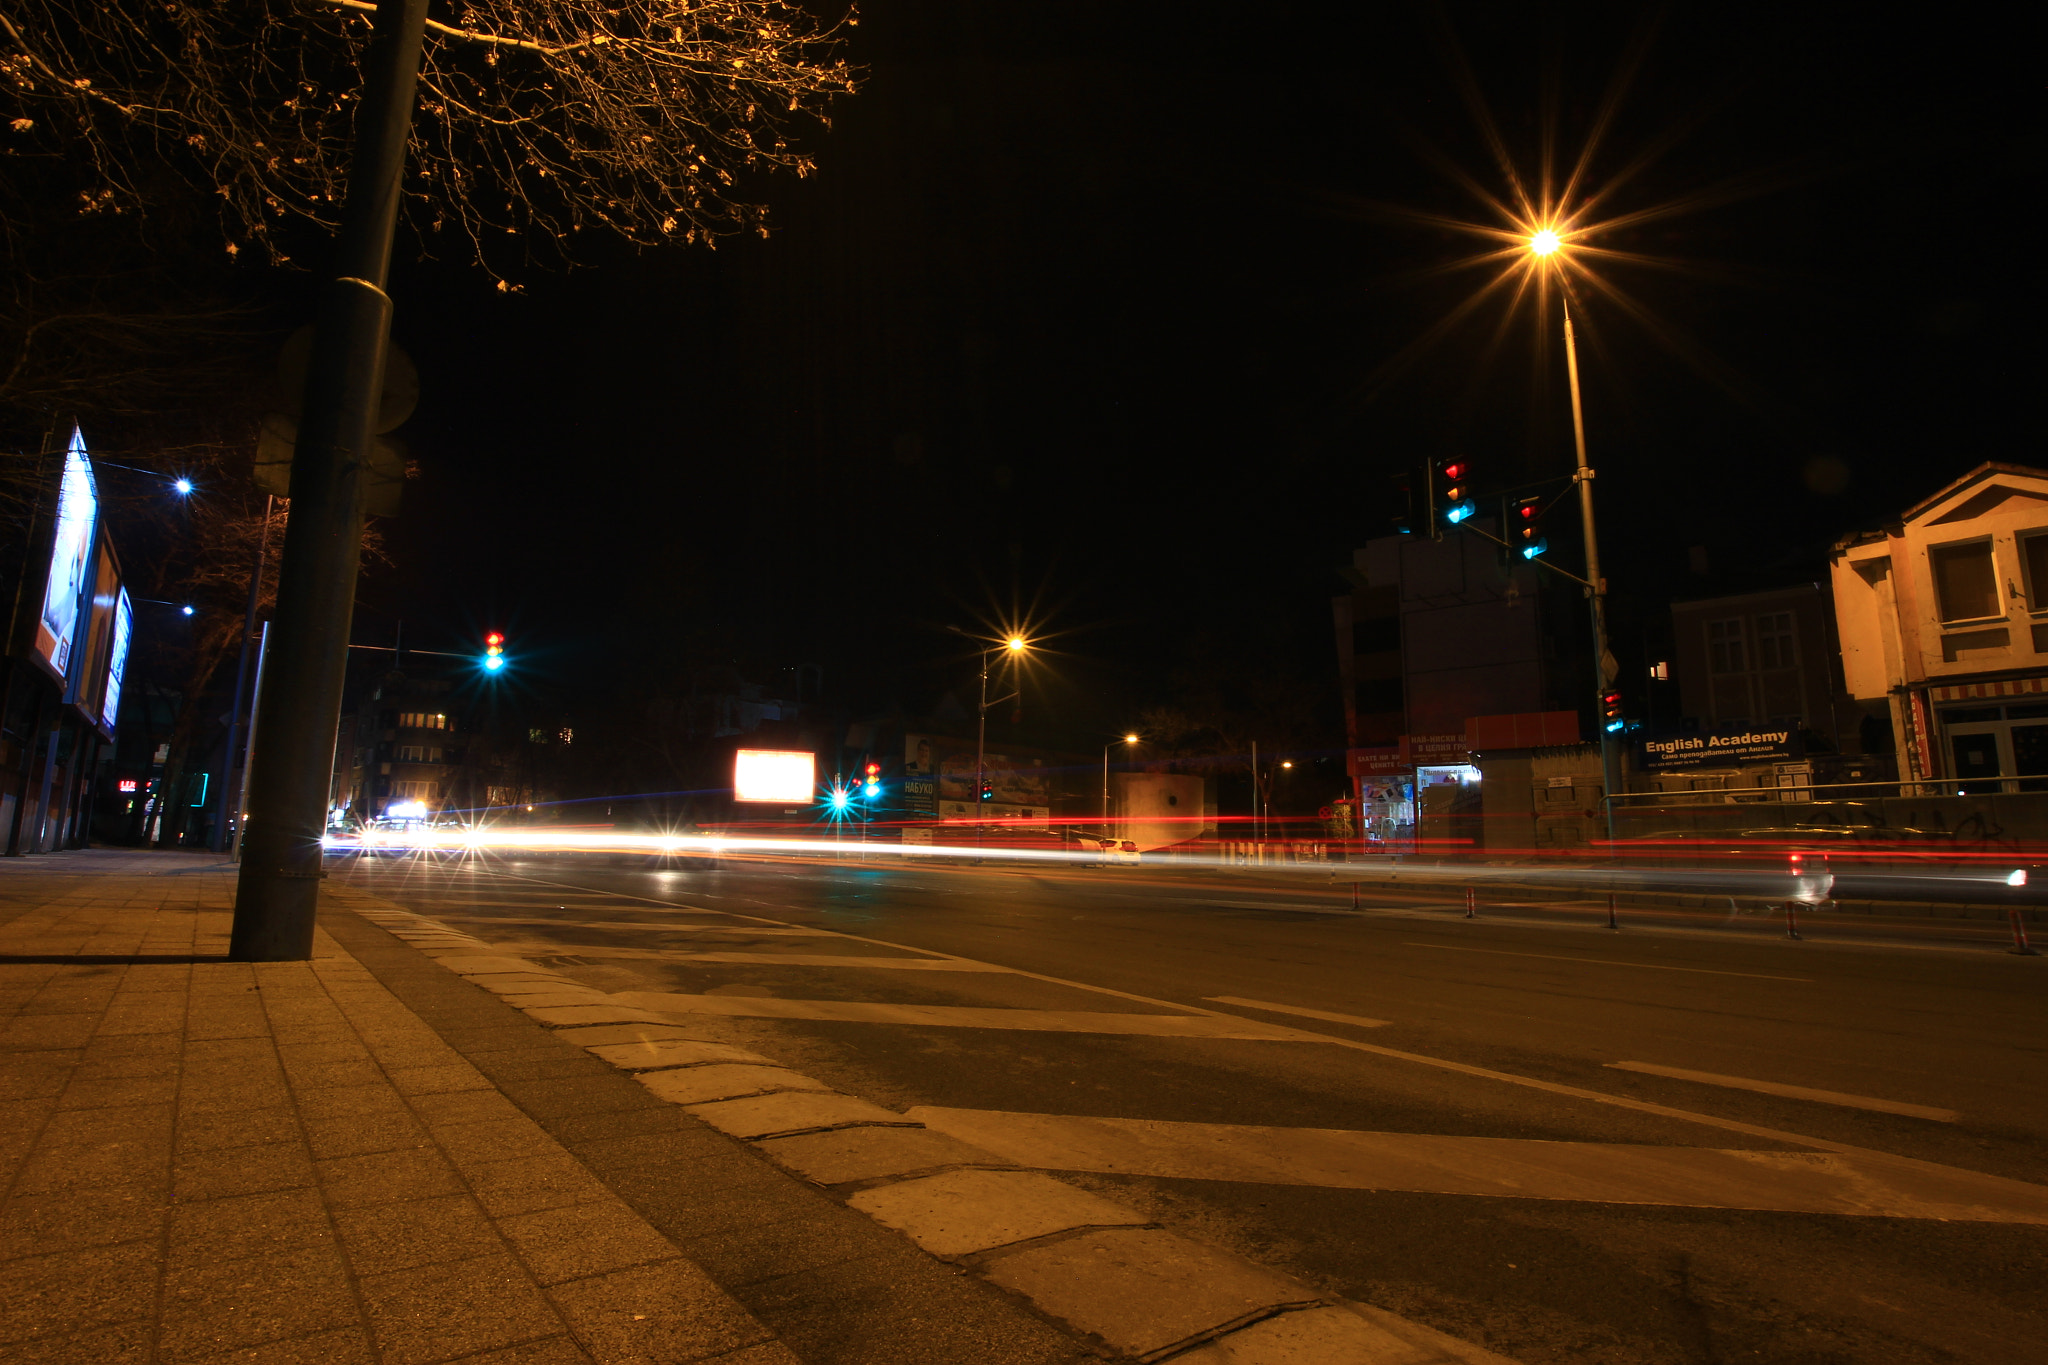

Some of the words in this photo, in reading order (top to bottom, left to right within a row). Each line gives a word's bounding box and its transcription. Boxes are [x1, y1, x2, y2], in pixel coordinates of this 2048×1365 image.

[1645, 737, 1704, 754] English
[1708, 730, 1789, 748] Academy
[1661, 753, 1678, 761] Само
[1679, 748, 1735, 759] преподаватели
[1748, 744, 1774, 753] Англия
[904, 781, 933, 794] НАБУКО
